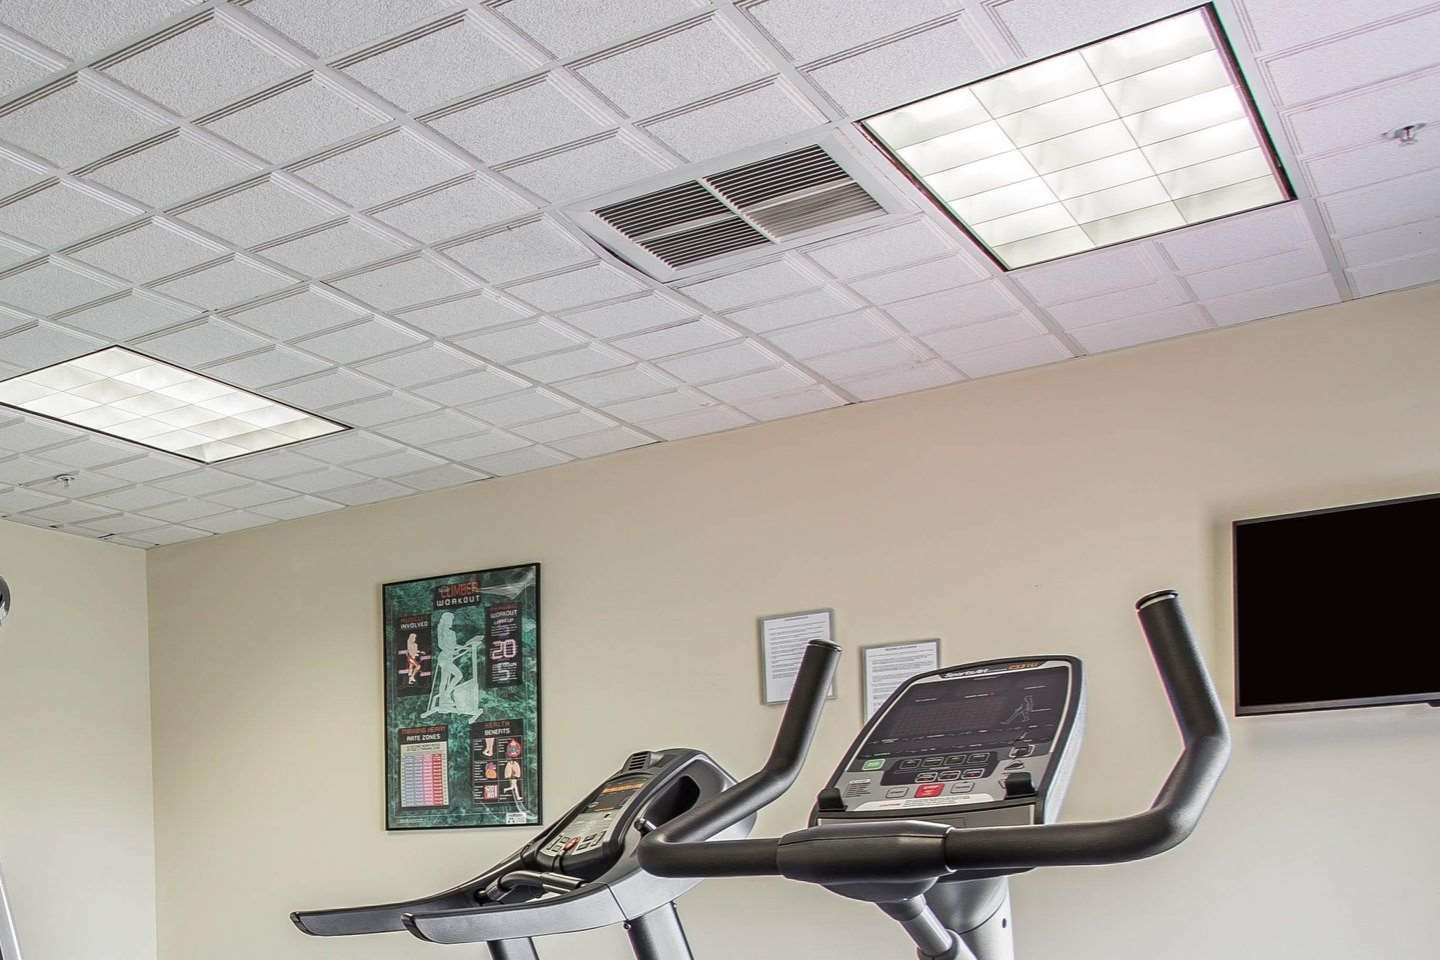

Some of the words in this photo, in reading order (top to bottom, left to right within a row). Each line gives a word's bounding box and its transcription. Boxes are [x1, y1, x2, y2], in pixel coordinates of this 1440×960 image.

[436, 595, 481, 607] WORKOUT
[490, 639, 517, 660] 20
[422, 733, 441, 741] ZONES
